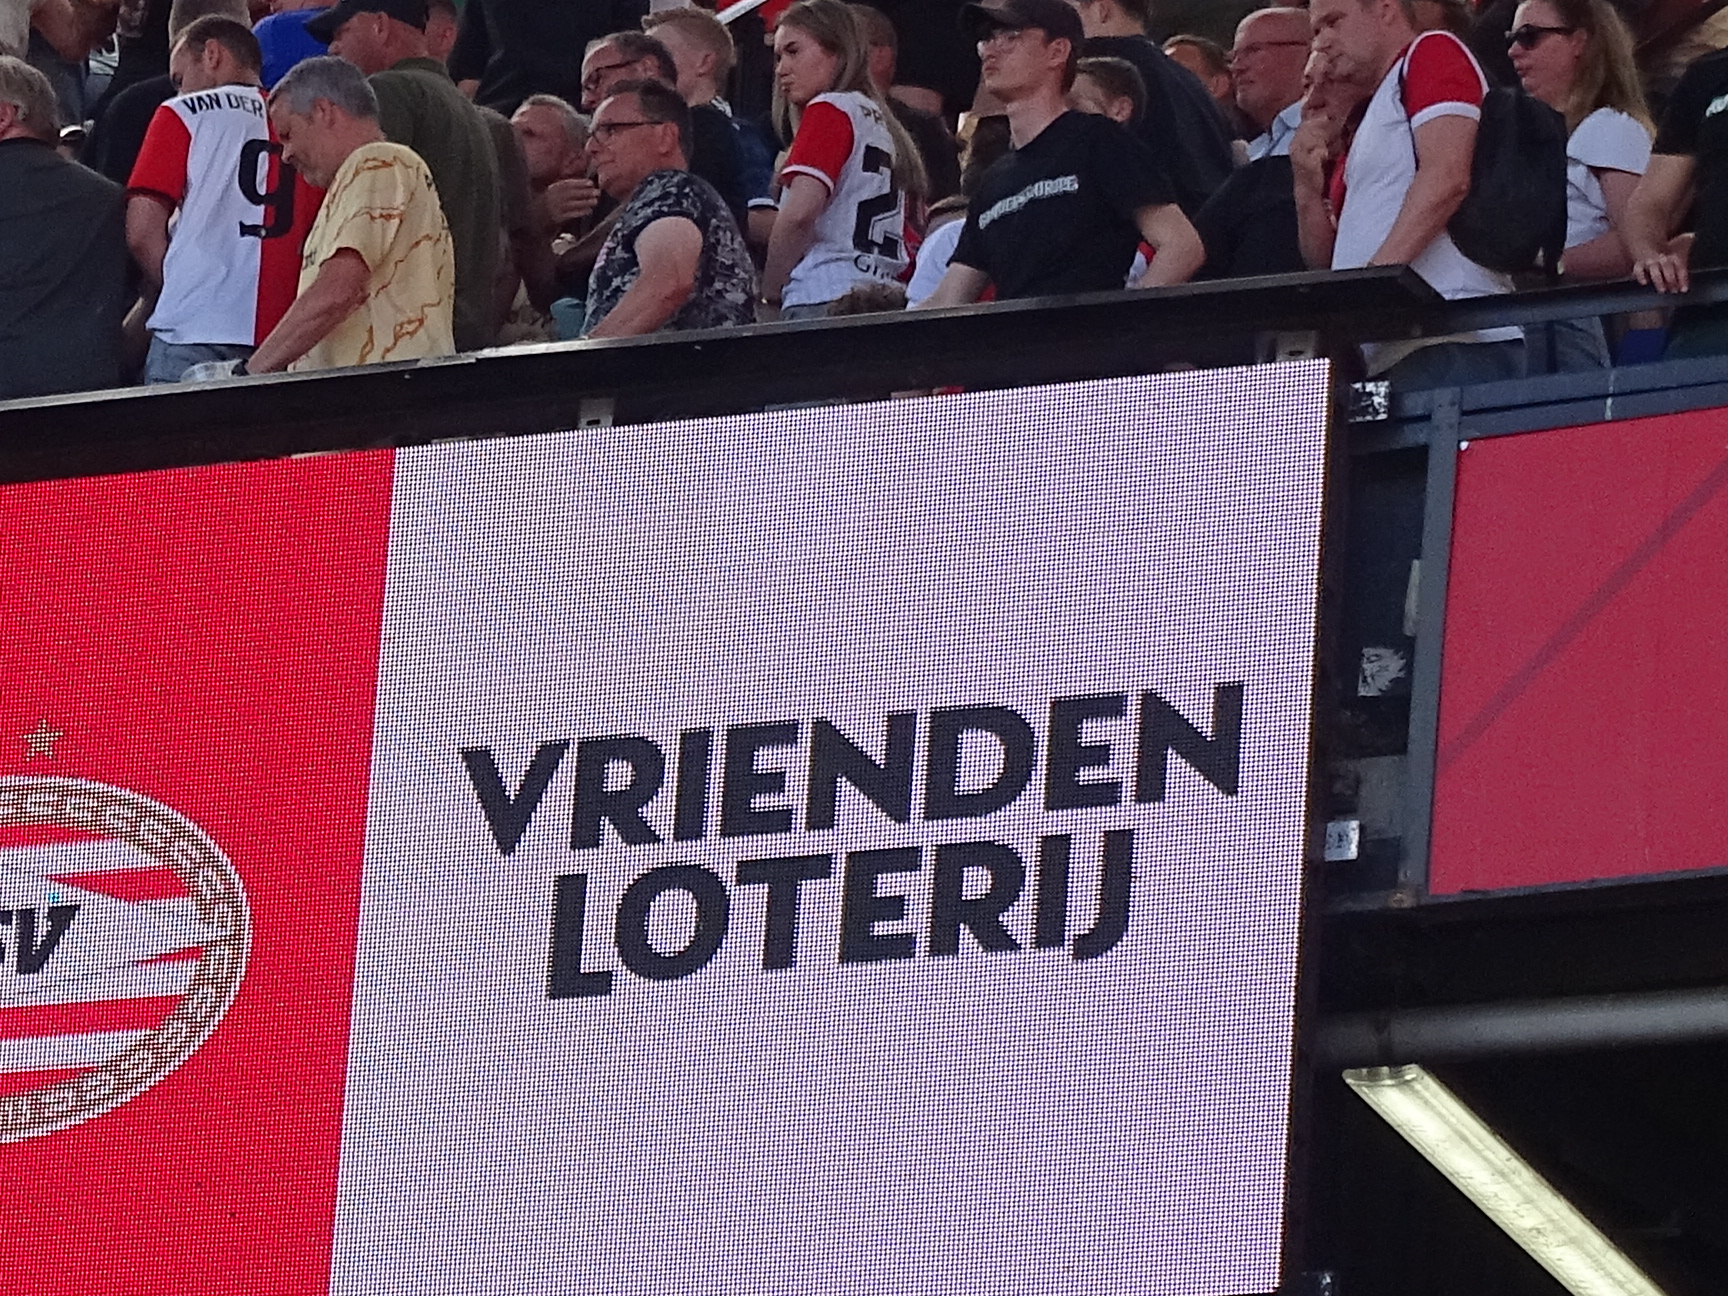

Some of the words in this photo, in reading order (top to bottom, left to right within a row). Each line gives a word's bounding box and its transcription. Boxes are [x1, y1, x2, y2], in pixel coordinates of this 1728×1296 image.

[183, 93, 223, 115] VAN
[227, 94, 265, 119] DER
[237, 137, 299, 238] 9
[459, 680, 1246, 857] VRIENDEN
[546, 826, 1138, 1001] LOTERIJ
